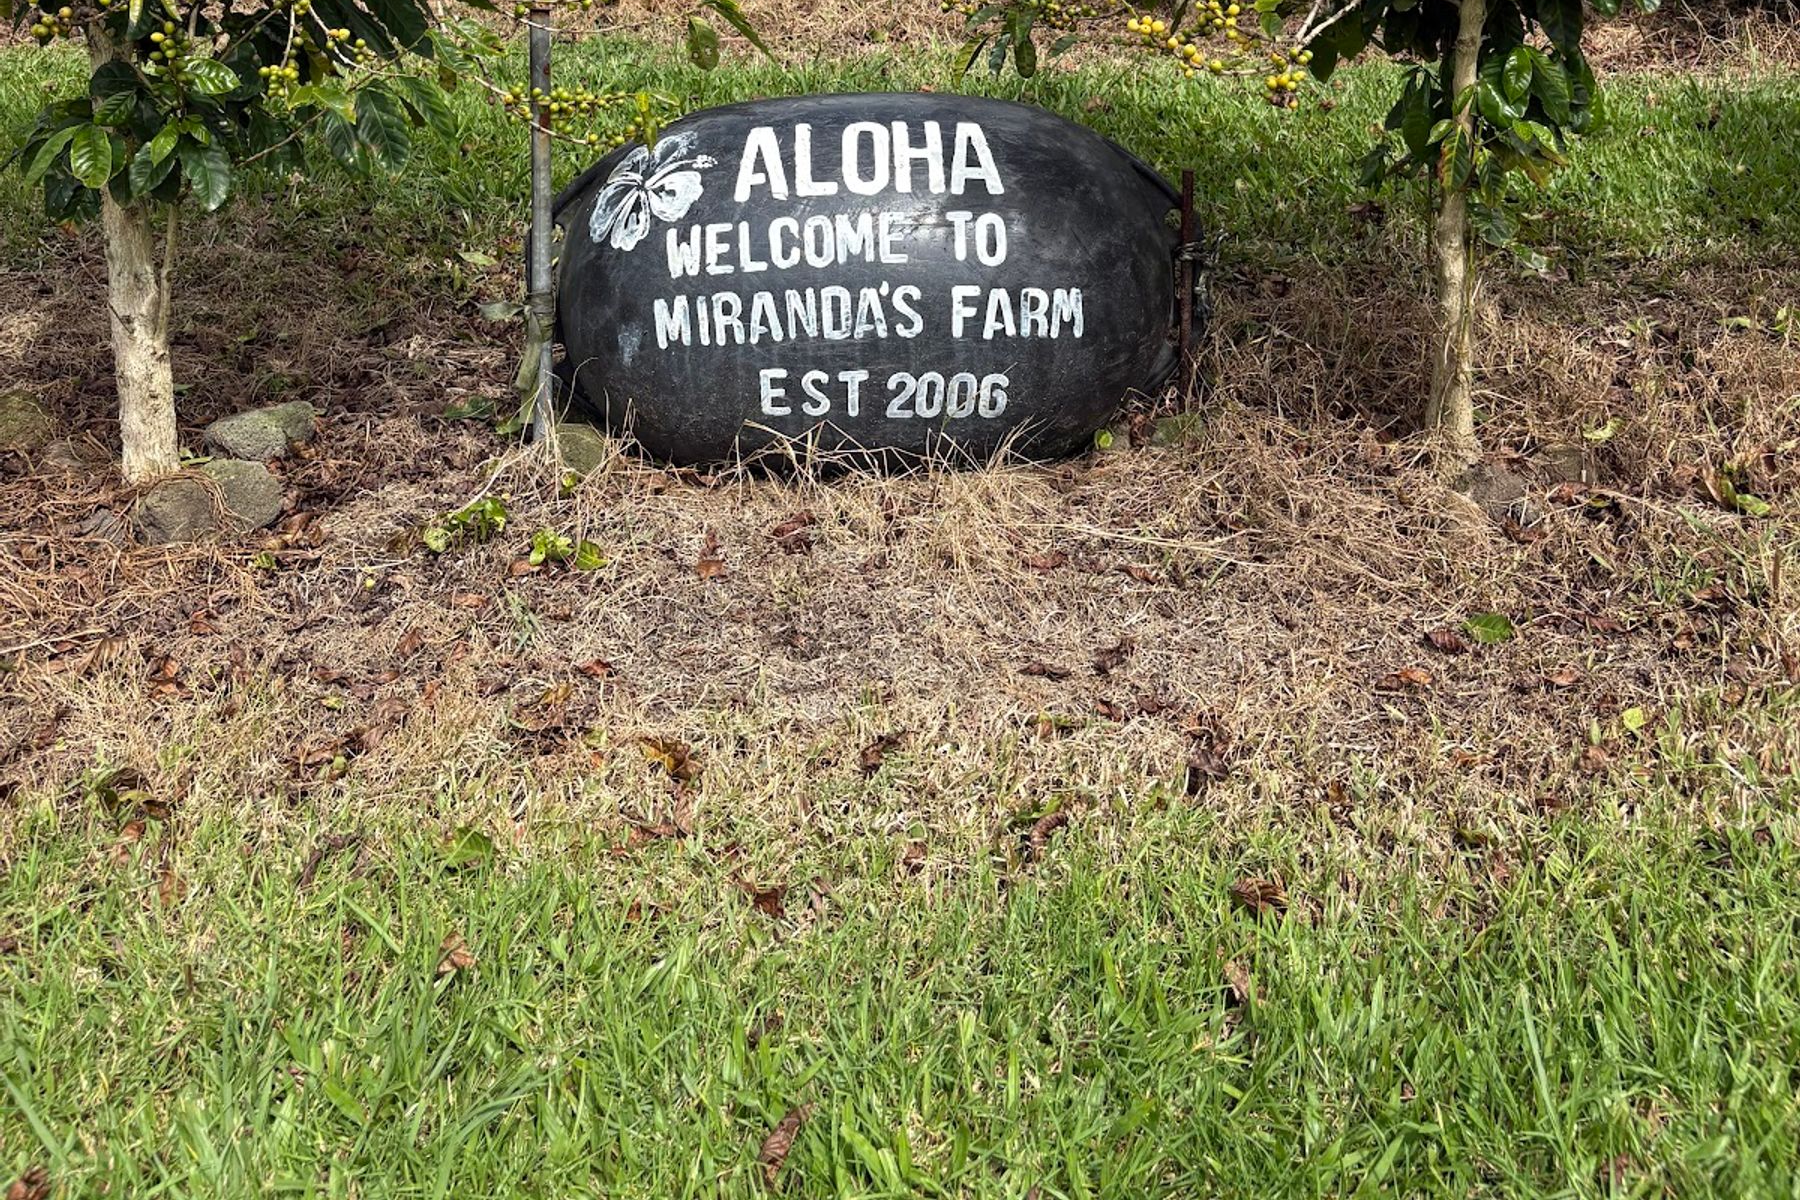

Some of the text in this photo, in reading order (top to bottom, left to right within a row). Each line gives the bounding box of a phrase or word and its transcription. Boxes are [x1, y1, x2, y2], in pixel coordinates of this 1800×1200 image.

[734, 120, 1005, 202] ALOHA
[666, 211, 1008, 278] WELCOME TO
[653, 281, 1085, 350] MIRANDA'S FARM
[759, 368, 1010, 419] EST 2006
